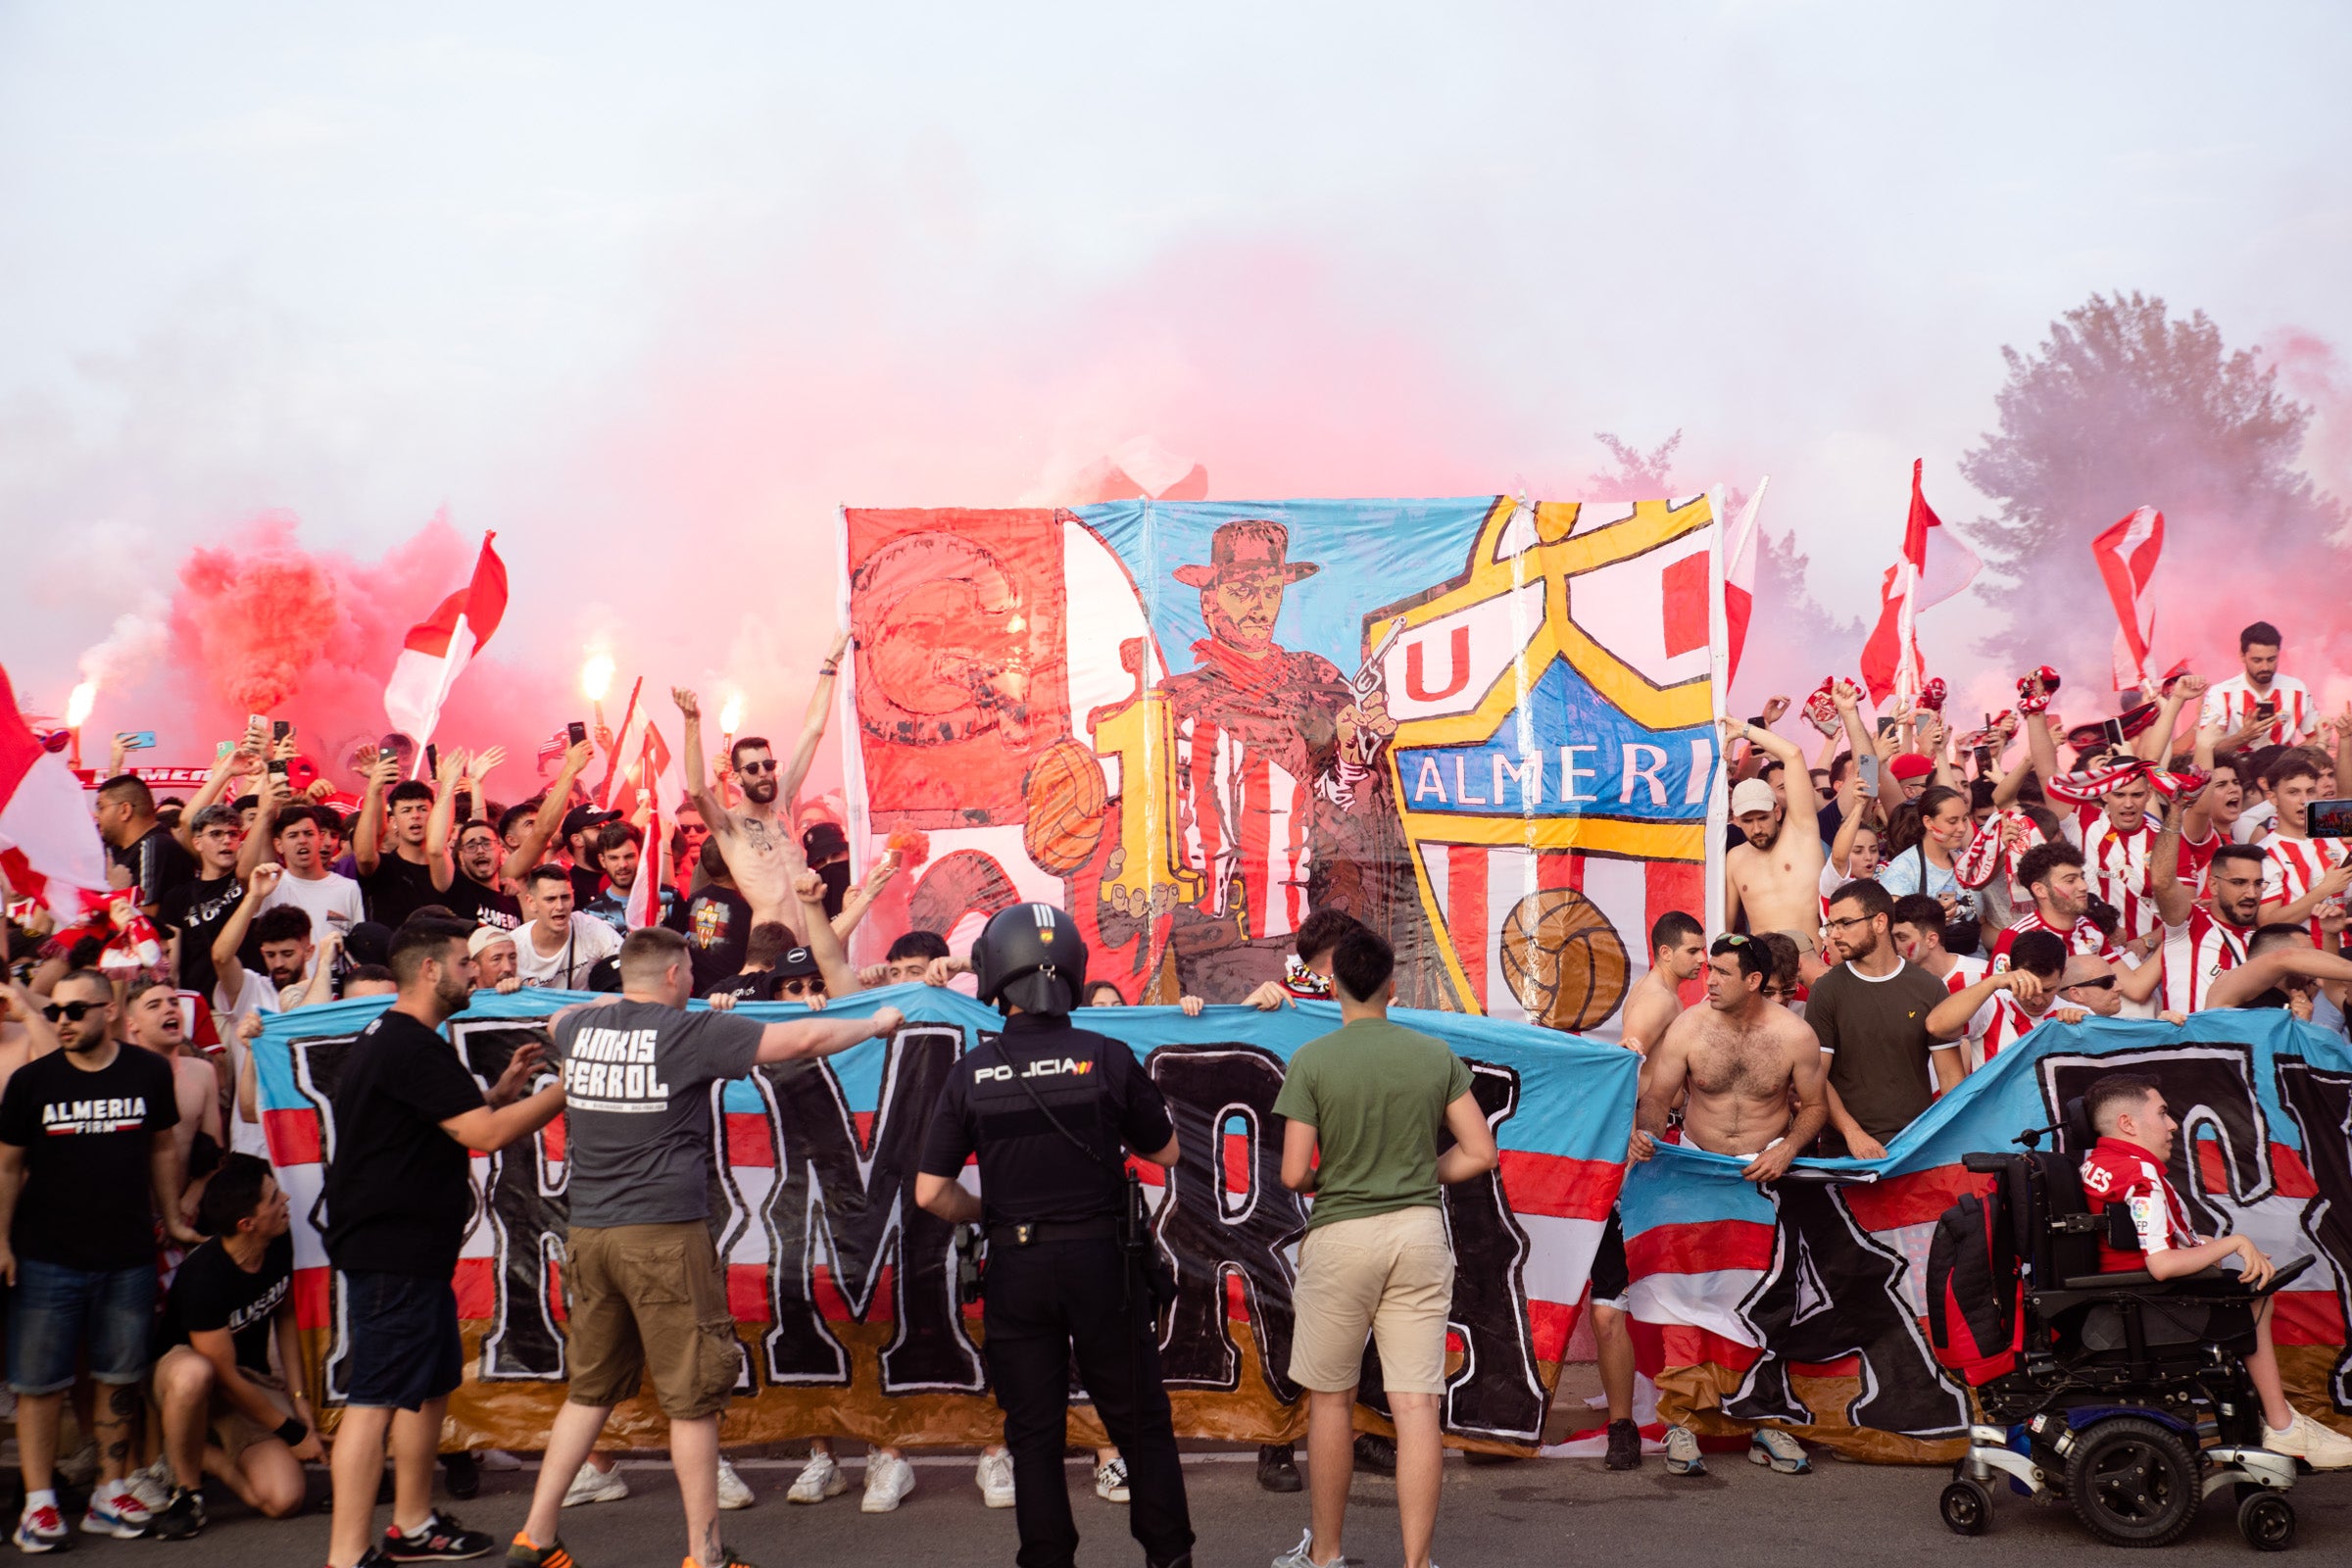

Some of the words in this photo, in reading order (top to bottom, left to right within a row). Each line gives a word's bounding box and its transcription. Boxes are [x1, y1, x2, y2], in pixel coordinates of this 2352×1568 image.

[571, 1027, 659, 1063] KINKIS
[564, 1058, 669, 1099] FERROL
[42, 1097, 147, 1124] ALMERIA
[75, 1120, 118, 1134] FIRM
